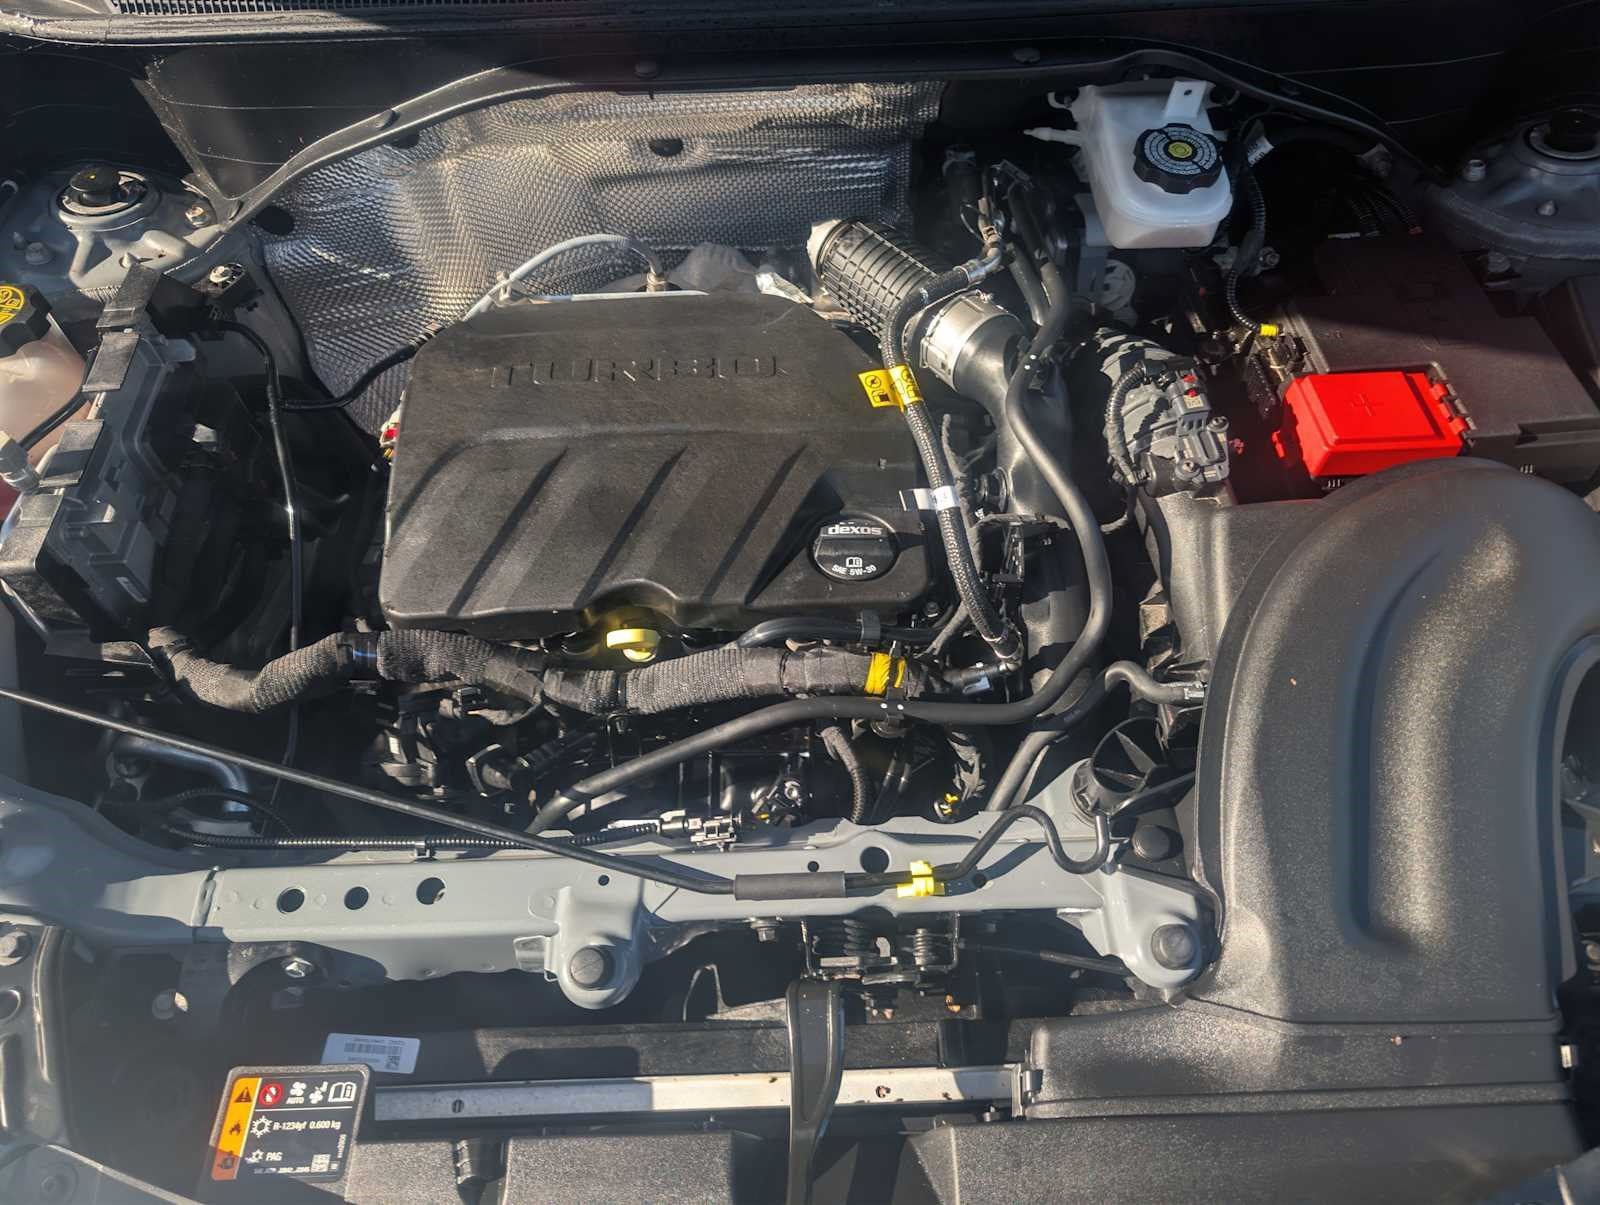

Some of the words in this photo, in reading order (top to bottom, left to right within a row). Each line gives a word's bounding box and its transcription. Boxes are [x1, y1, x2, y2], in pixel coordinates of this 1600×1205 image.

[473, 353, 779, 388] TURBO
[828, 524, 883, 535] dexos
[832, 564, 847, 574] SAE
[849, 564, 877, 576] 5W-30
[285, 1096, 305, 1105] AUTO
[331, 1120, 341, 1130] kg
[265, 1151, 283, 1161] PAG
